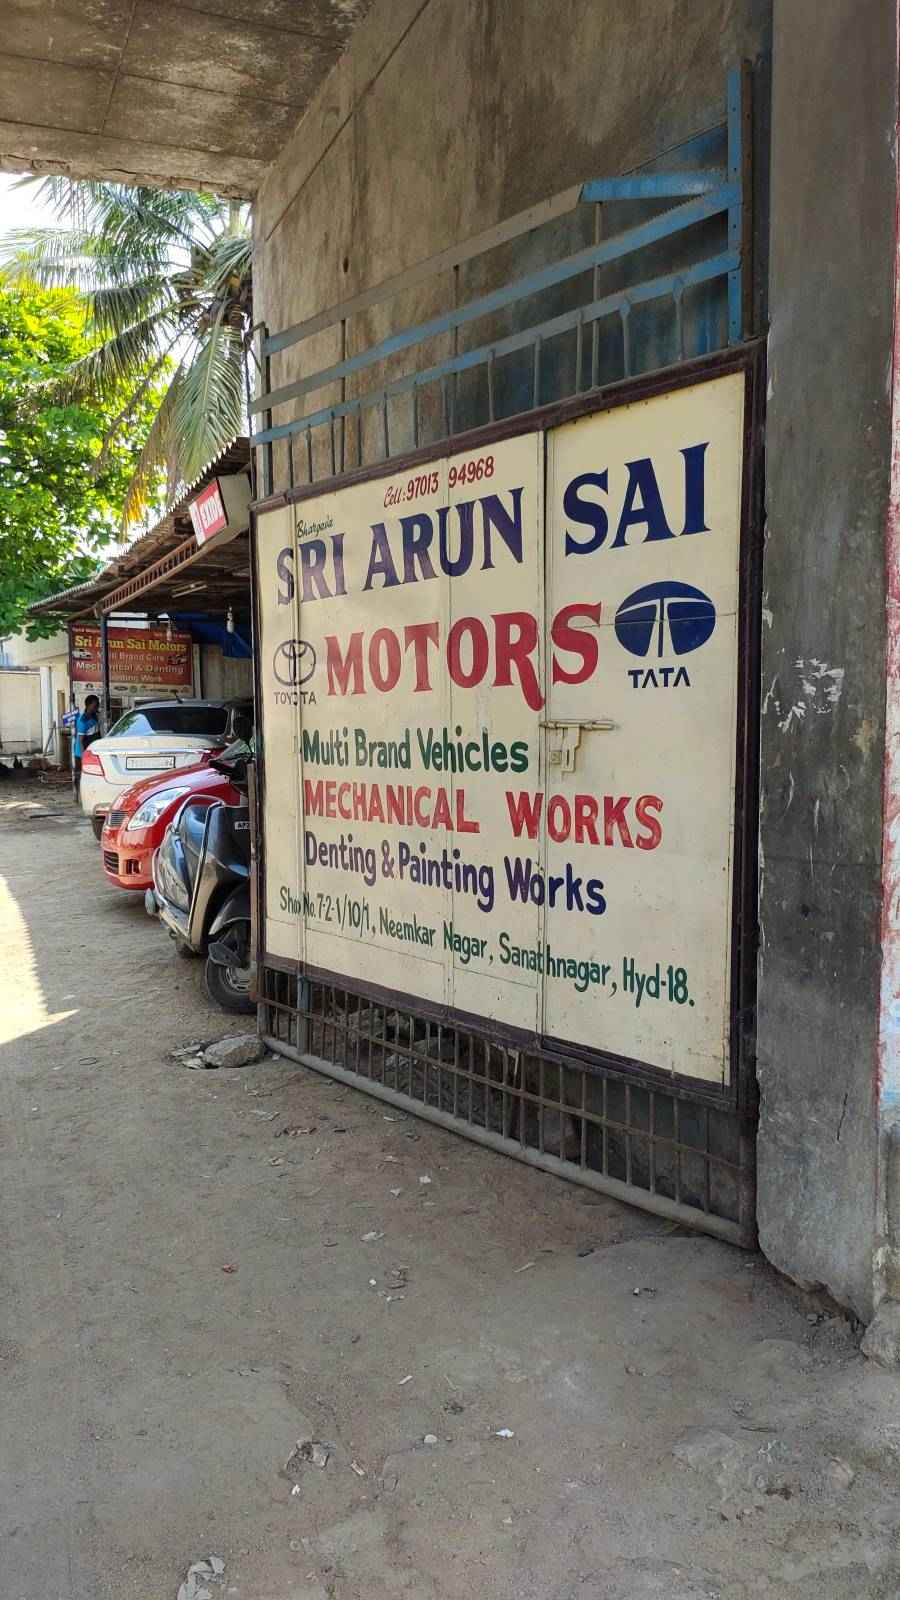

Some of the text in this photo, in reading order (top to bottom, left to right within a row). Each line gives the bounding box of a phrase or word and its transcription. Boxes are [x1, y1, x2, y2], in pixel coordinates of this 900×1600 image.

[448, 456, 495, 488] 94968
[276, 442, 712, 606] SRI ARUN SAI
[75, 635, 94, 648] Sri
[126, 638, 147, 650] Sai
[148, 640, 188, 652] Motors
[324, 601, 601, 712] MOTORS
[273, 690, 317, 706] TOYOTA
[627, 666, 691, 689] TATA
[303, 726, 529, 773] Multi Brand Vehicles
[304, 779, 664, 850] MECHANICAL WORKS
[305, 831, 607, 915] Denting & Painting Works
[379, 905, 436, 947] Neemkar
[499, 931, 617, 998] Sanathnagar,
[623, 956, 695, 1008] Hyd-18.
